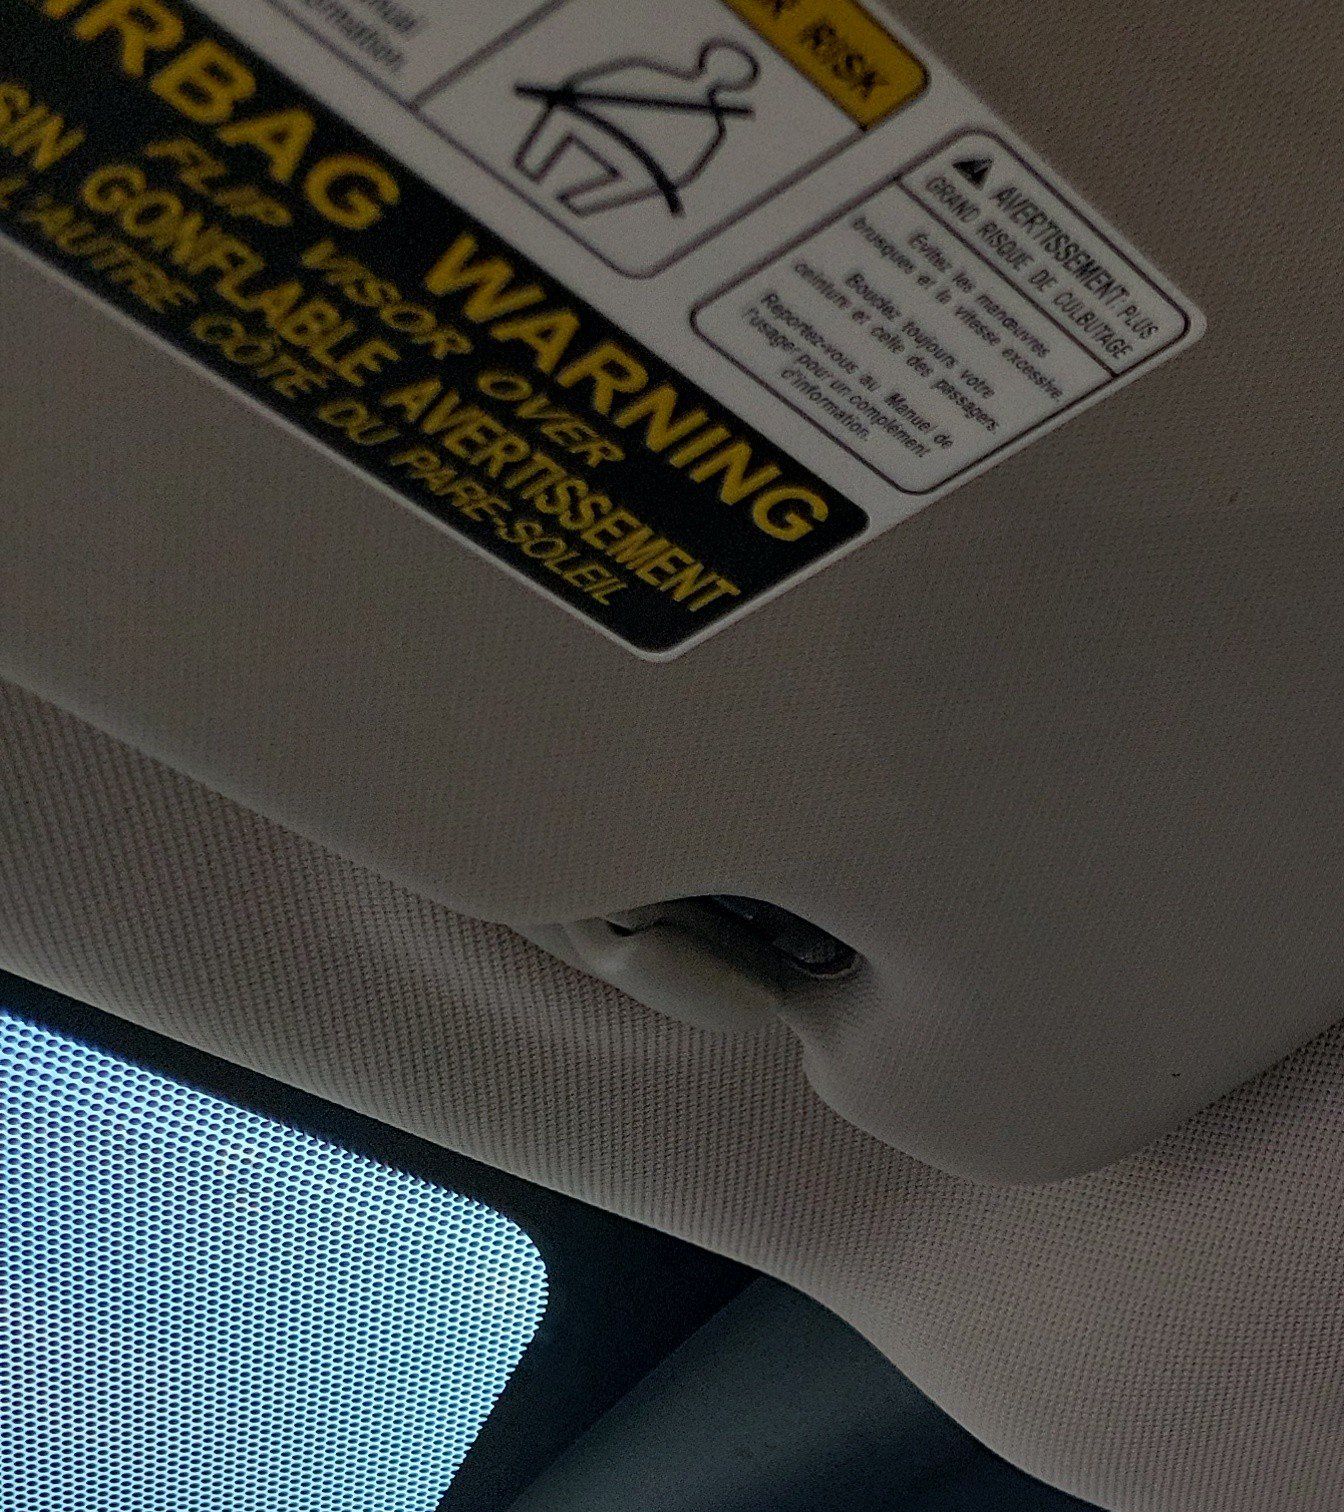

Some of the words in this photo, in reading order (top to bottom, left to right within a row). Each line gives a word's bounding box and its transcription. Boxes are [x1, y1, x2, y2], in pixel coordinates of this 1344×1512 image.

[43, 0, 399, 229] RBAG
[424, 234, 830, 542] WARNING
[924, 175, 981, 224] GRAND
[975, 219, 1035, 271] RISQUE
[1026, 267, 1059, 293] DE
[1051, 290, 1134, 360] CULBUTAGE
[300, 237, 473, 359] VISOR
[475, 369, 626, 468] OVER
[899, 319, 958, 370] toujours
[959, 367, 996, 400] votre
[953, 304, 1002, 347] vitesse
[1115, 303, 1160, 341] PLUS
[78, 164, 401, 387] GONFLABLE
[381, 377, 740, 610] AVERTISSEMENT
[792, 352, 835, 380] pour
[827, 378, 854, 398] un
[904, 353, 935, 379] des
[857, 372, 880, 393] au
[883, 391, 937, 436] Manuel
[932, 431, 954, 451] de
[316, 397, 397, 445] DU
[390, 445, 627, 605] PARE-SOLEIL
